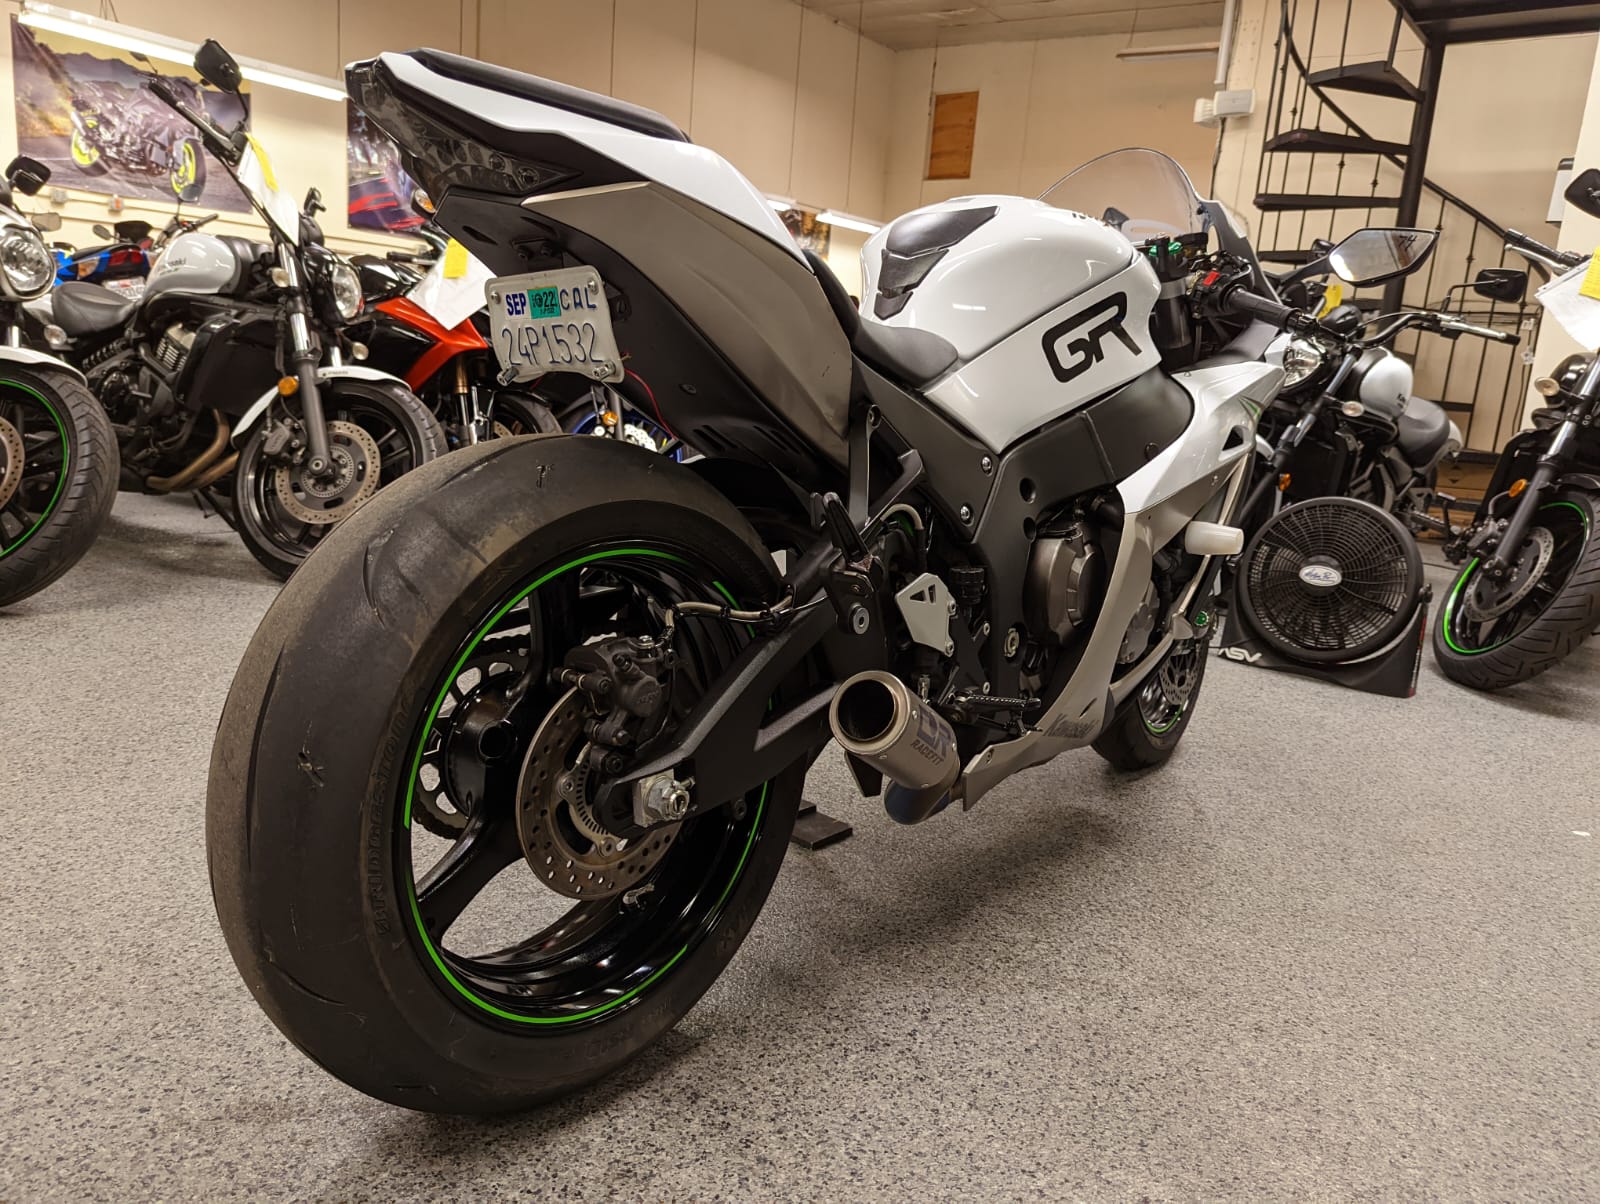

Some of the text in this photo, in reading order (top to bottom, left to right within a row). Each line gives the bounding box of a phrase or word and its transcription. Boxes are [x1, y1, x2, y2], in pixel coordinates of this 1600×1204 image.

[505, 293, 527, 316] SEP
[543, 291, 556, 308] 22
[560, 287, 597, 311] CAL
[502, 322, 604, 366] 24P1532
[1041, 291, 1143, 383] GR
[1218, 647, 1263, 663] ASV
[910, 738, 945, 766] RACEFIT
